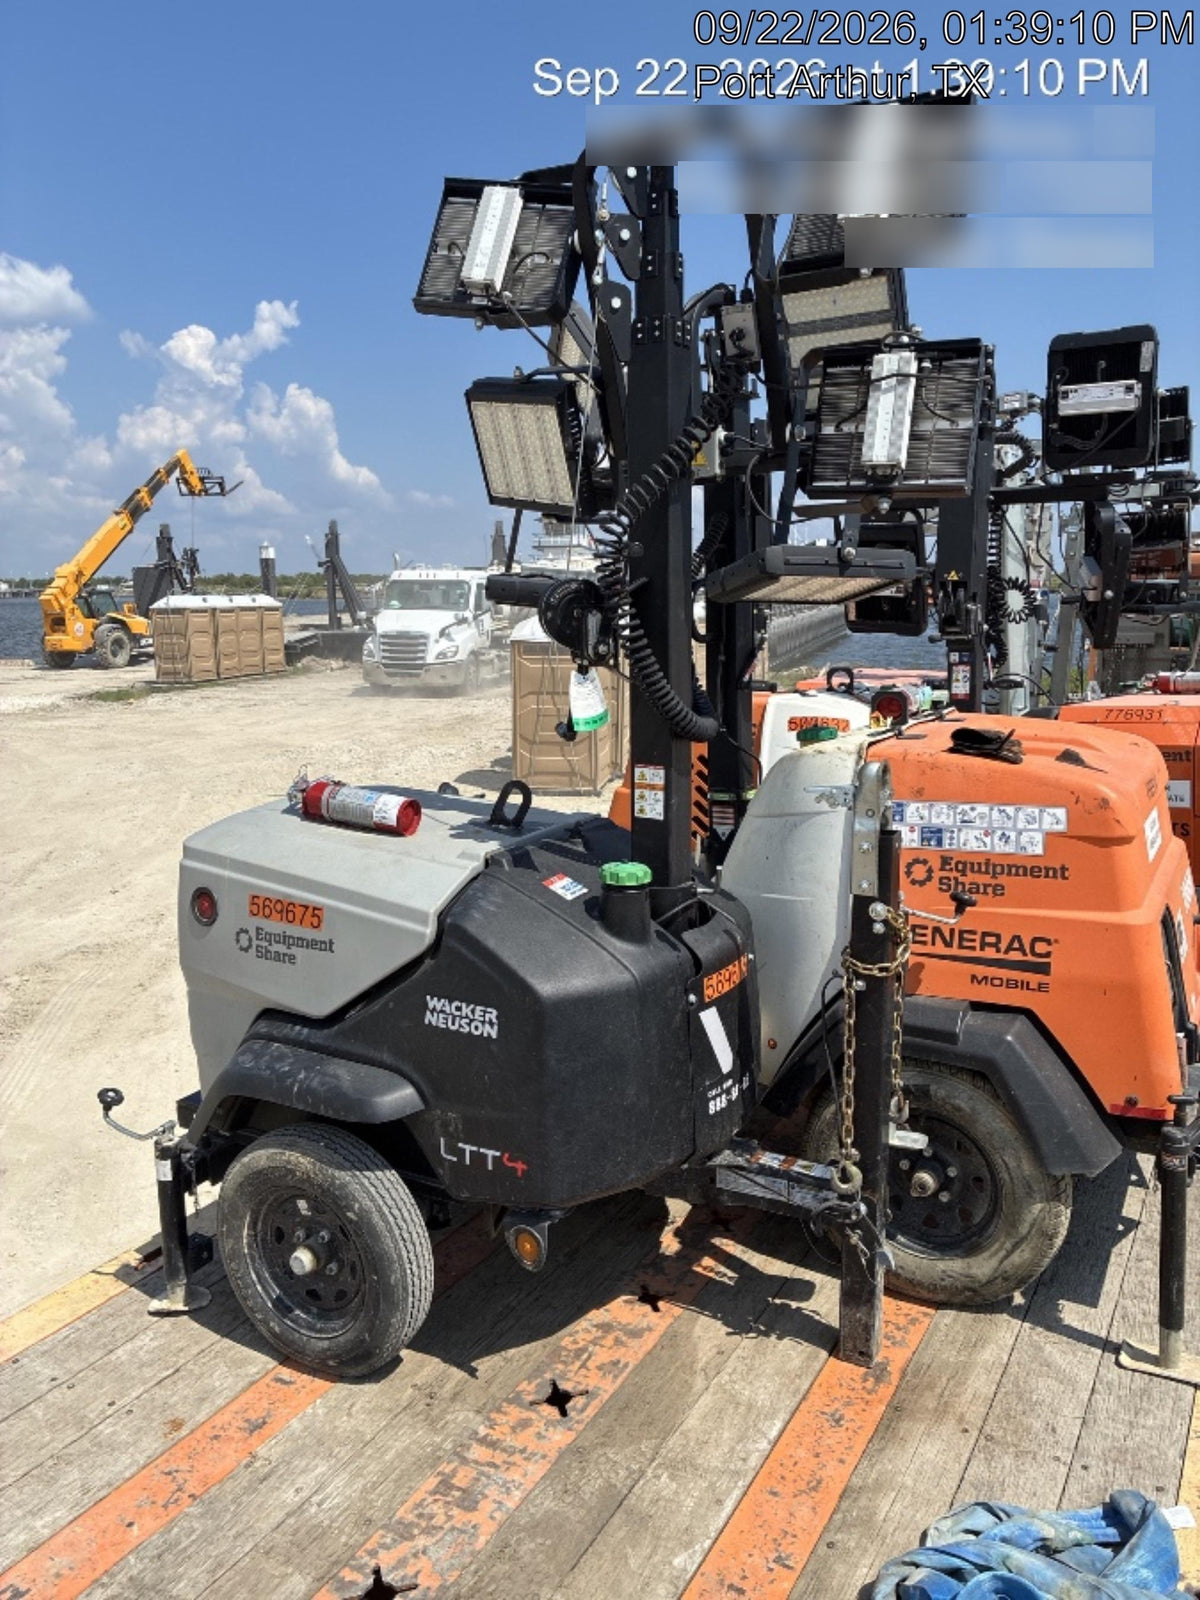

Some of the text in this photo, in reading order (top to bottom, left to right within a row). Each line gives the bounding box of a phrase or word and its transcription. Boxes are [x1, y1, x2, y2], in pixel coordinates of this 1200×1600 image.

[1104, 708, 1164, 721] 776931
[939, 855, 1070, 881] Equipment
[938, 875, 1006, 897] Share
[249, 895, 323, 929] 569675
[255, 926, 336, 954] Equipment
[910, 923, 1053, 959] ENERAC
[255, 944, 297, 966] Share
[970, 973, 1050, 993] MOBILE
[425, 994, 498, 1024] WACKER
[424, 1009, 499, 1040] NEUSON
[440, 1136, 528, 1178] LTT4
